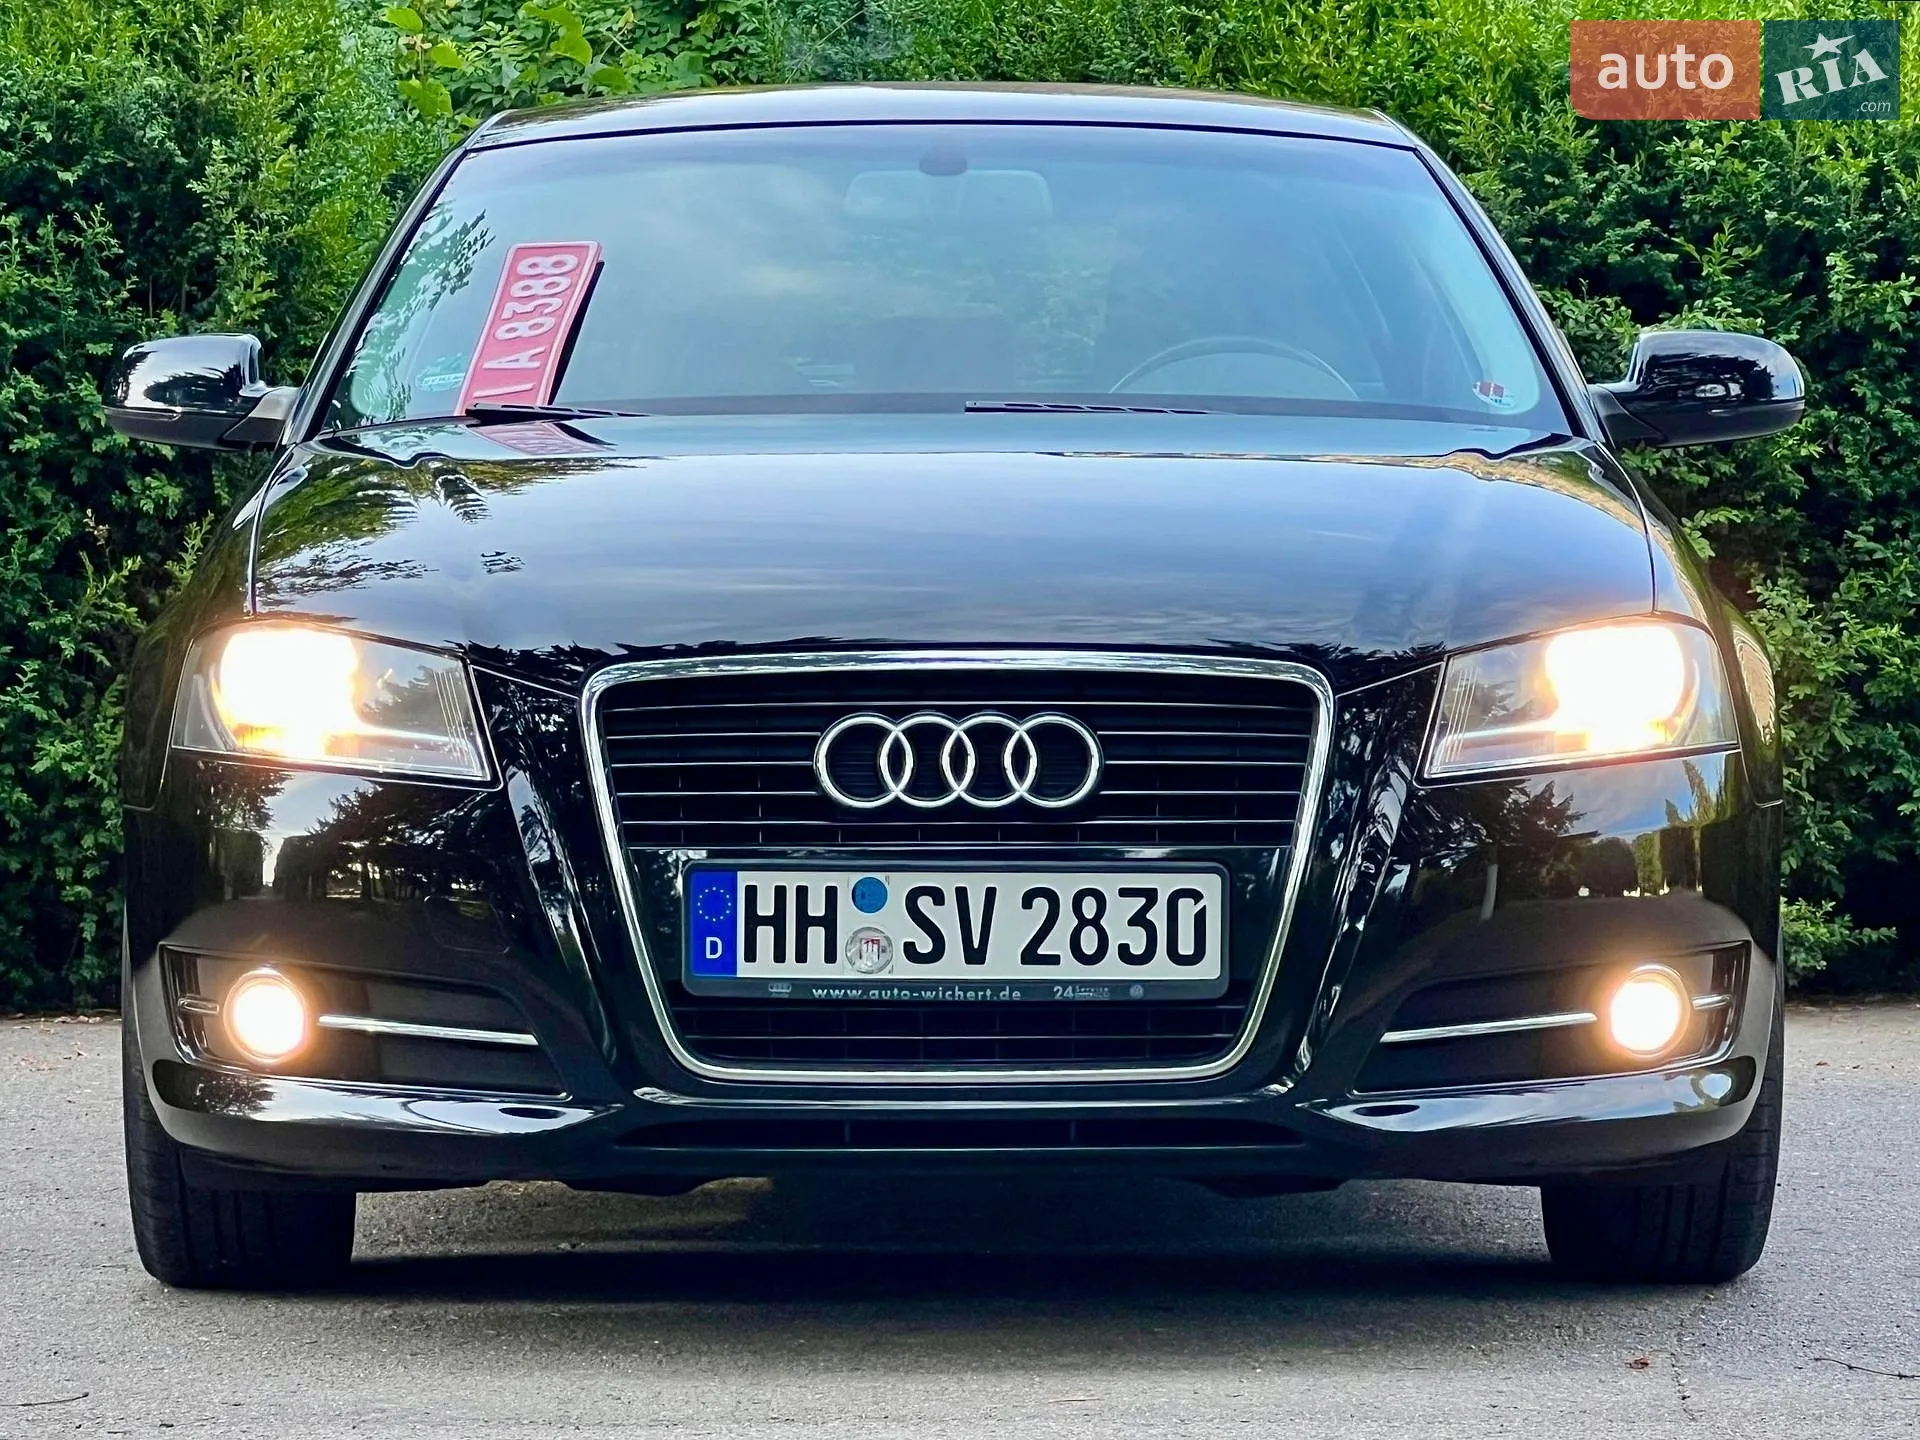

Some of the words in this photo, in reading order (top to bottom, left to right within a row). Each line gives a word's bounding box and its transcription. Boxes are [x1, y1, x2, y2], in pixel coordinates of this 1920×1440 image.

[495, 254, 578, 340] 8388
[743, 884, 839, 965] HH
[902, 885, 997, 966] SV
[1019, 886, 1208, 967] 2830
[705, 937, 723, 960] D
[812, 985, 1022, 1001] www.auto-wichert.de
[1053, 985, 1074, 1000] 24
